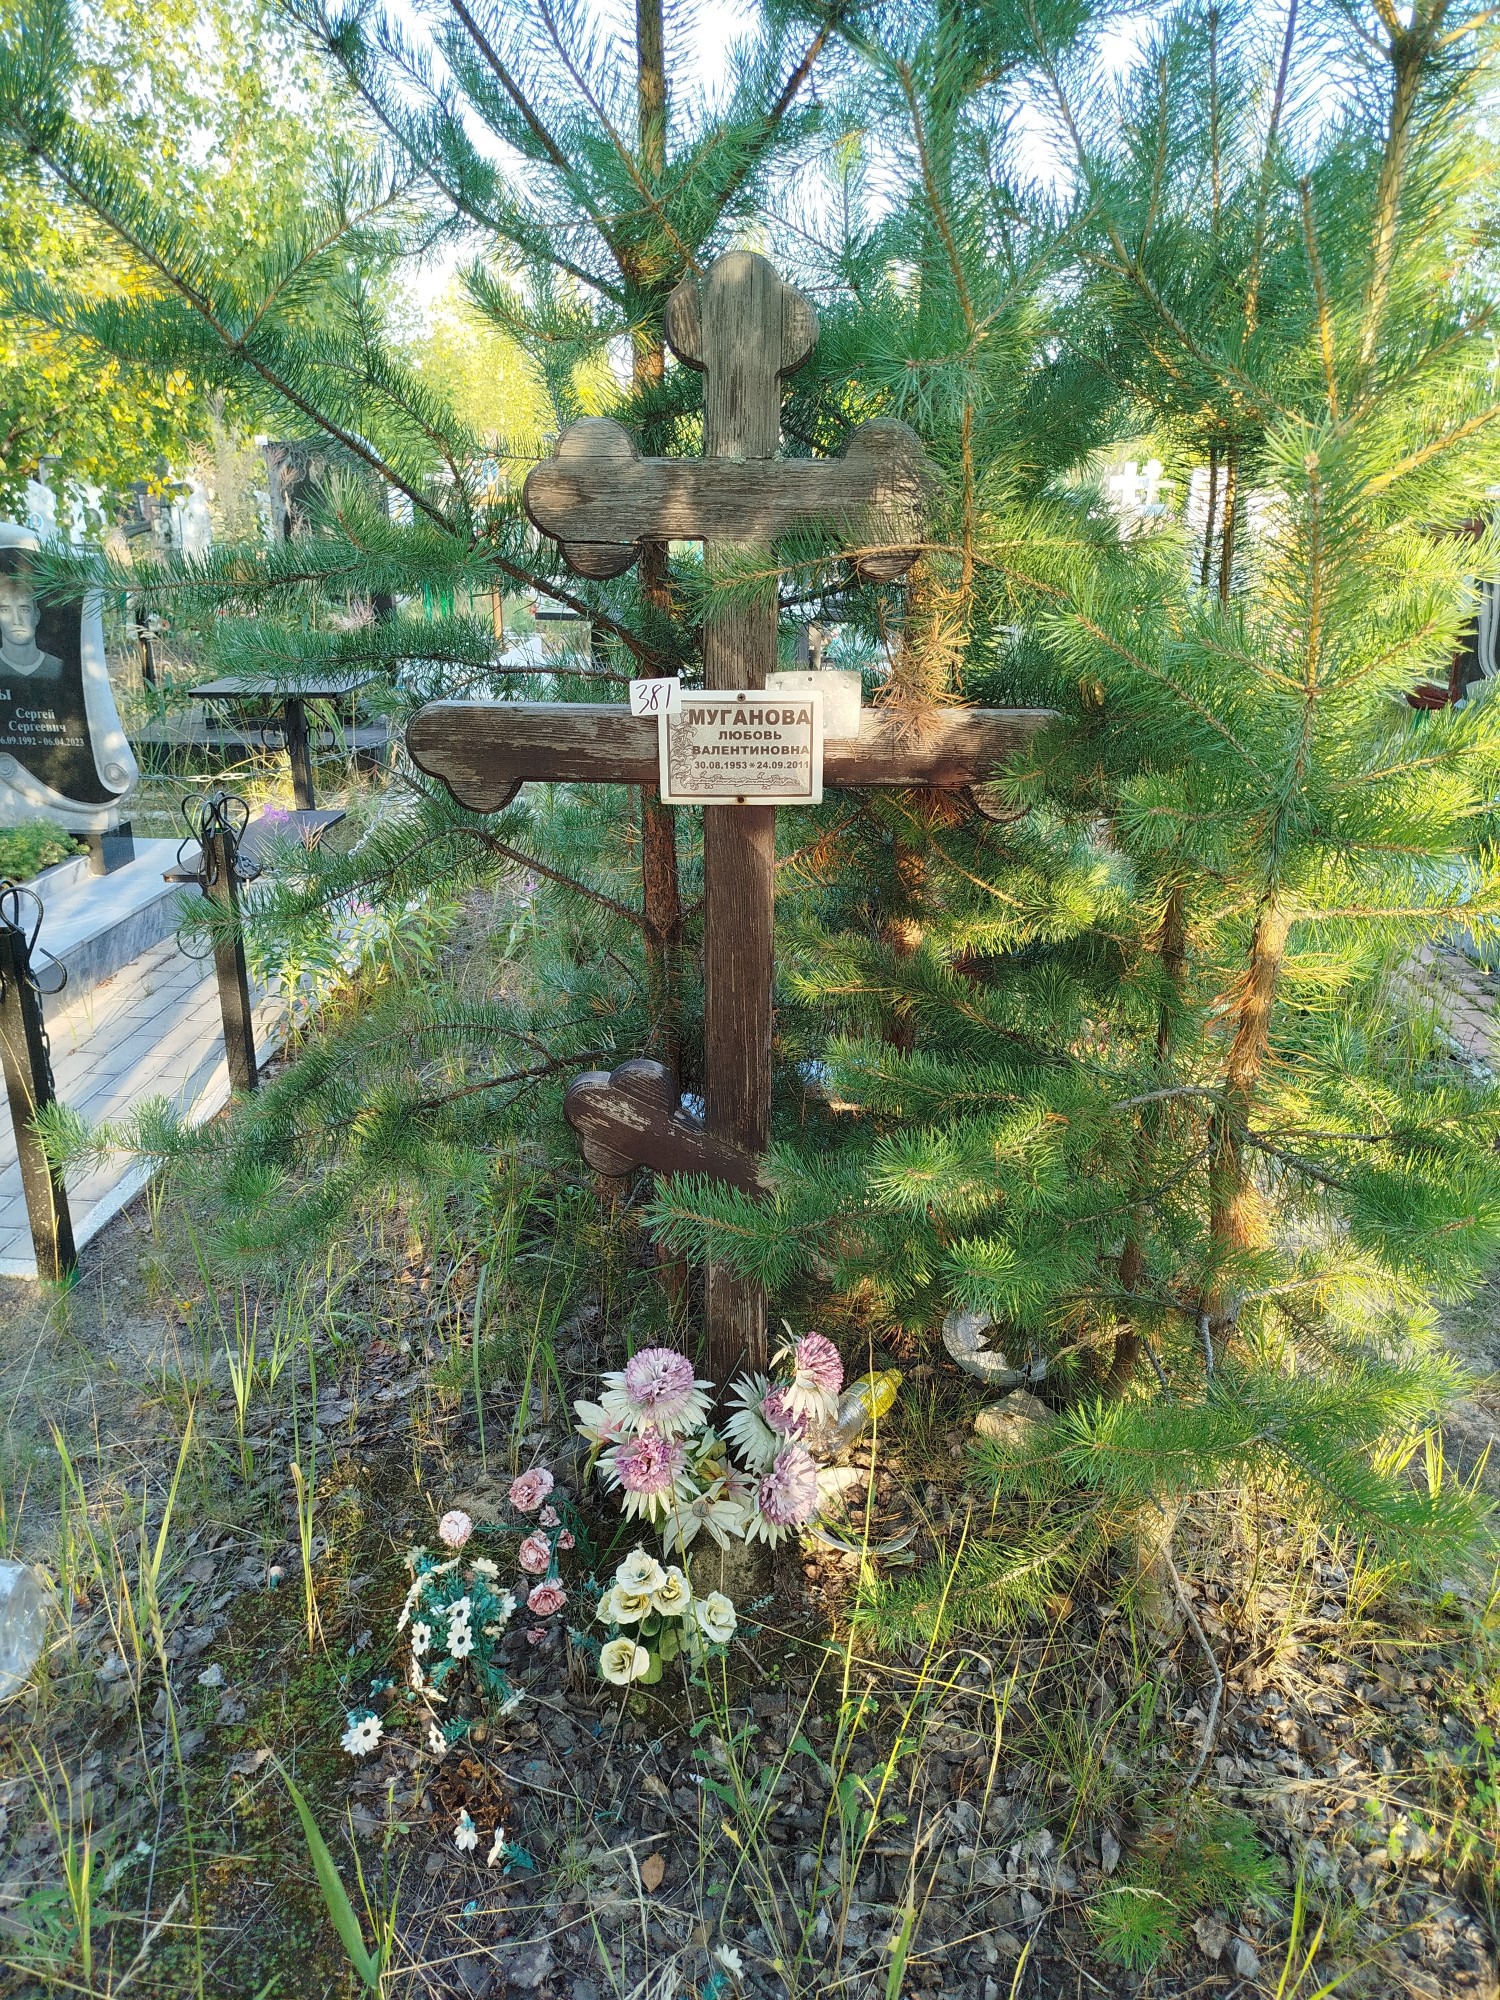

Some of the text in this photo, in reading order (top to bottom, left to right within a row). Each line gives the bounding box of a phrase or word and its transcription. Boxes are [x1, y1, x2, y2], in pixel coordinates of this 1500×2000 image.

[635, 684, 672, 713] 381
[15, 707, 56, 722] Сергей
[688, 709, 811, 726] МУГАНОВА
[8, 720, 67, 734] Сергеевич
[43, 738, 85, 748] 06.04.2023
[718, 731, 782, 741] ЛЮБОВЬ
[693, 746, 810, 755] ВАЛЕНТИНОВНА
